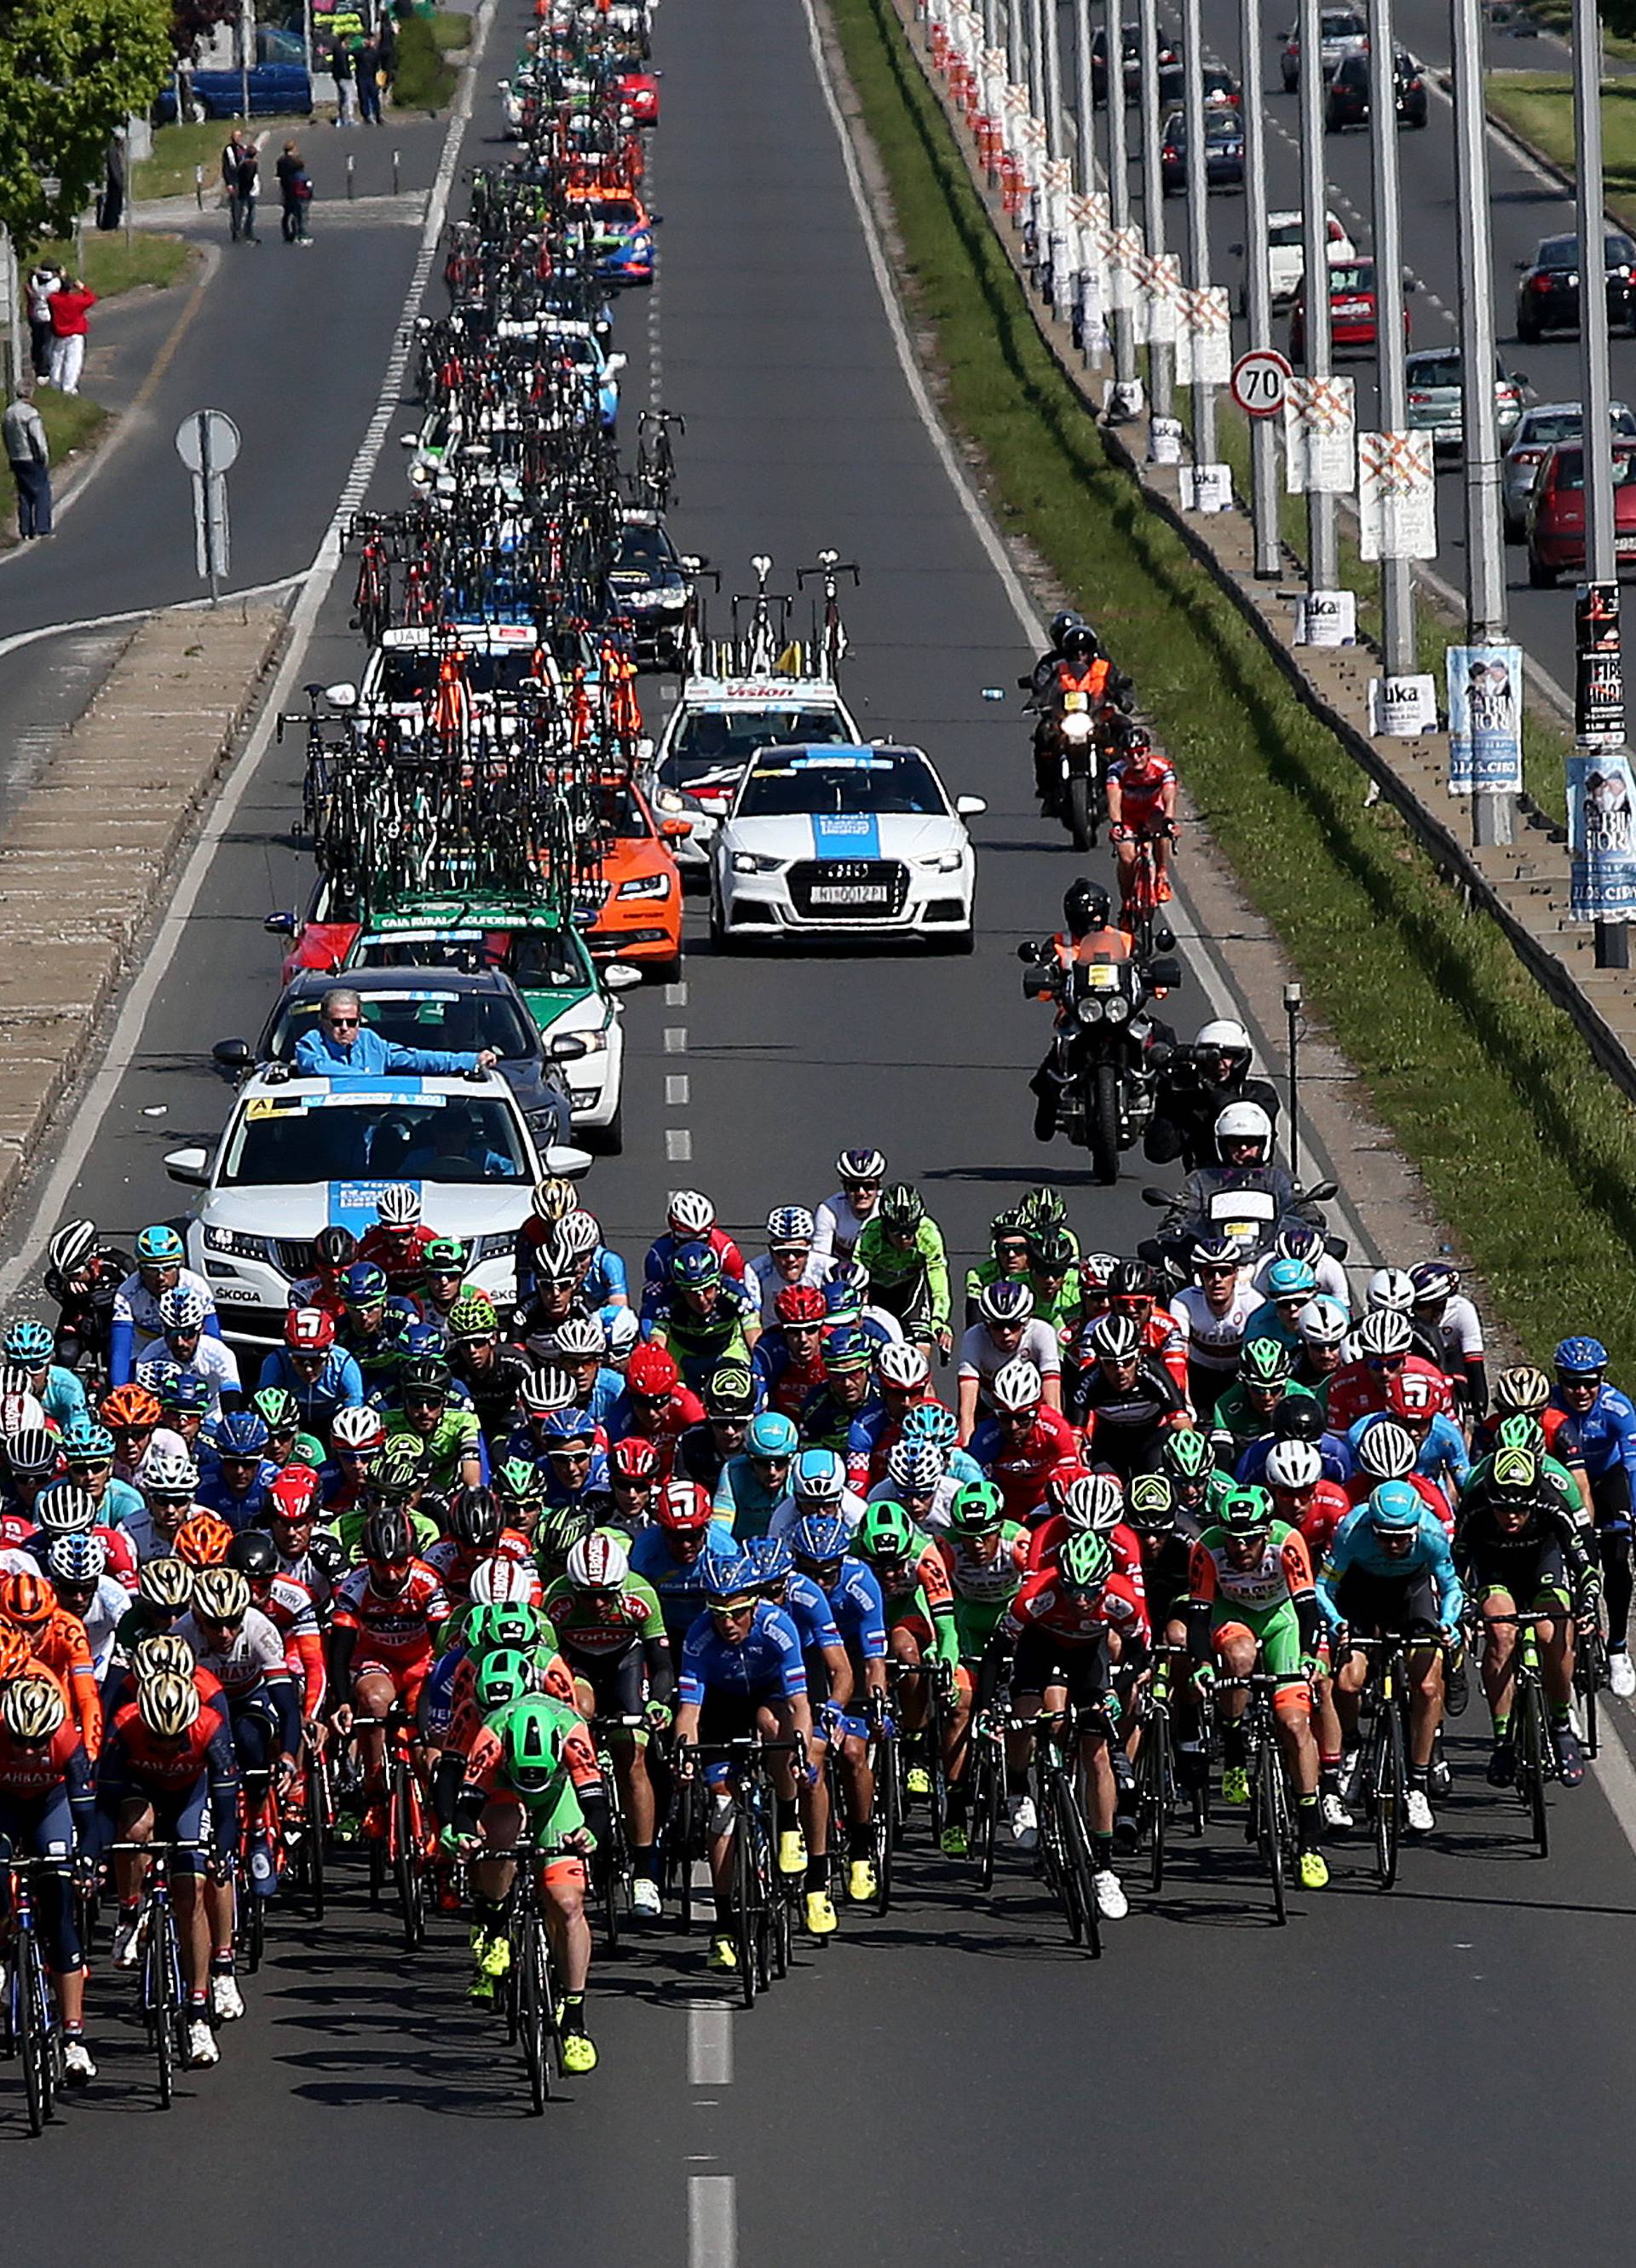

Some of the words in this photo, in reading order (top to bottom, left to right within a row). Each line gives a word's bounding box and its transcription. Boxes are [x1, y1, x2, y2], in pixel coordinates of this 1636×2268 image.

[1246, 369, 1279, 400] 70
[727, 685, 794, 697] Vision
[216, 1286, 261, 1302] ŠKODA
[54, 1619, 89, 1651] CCC
